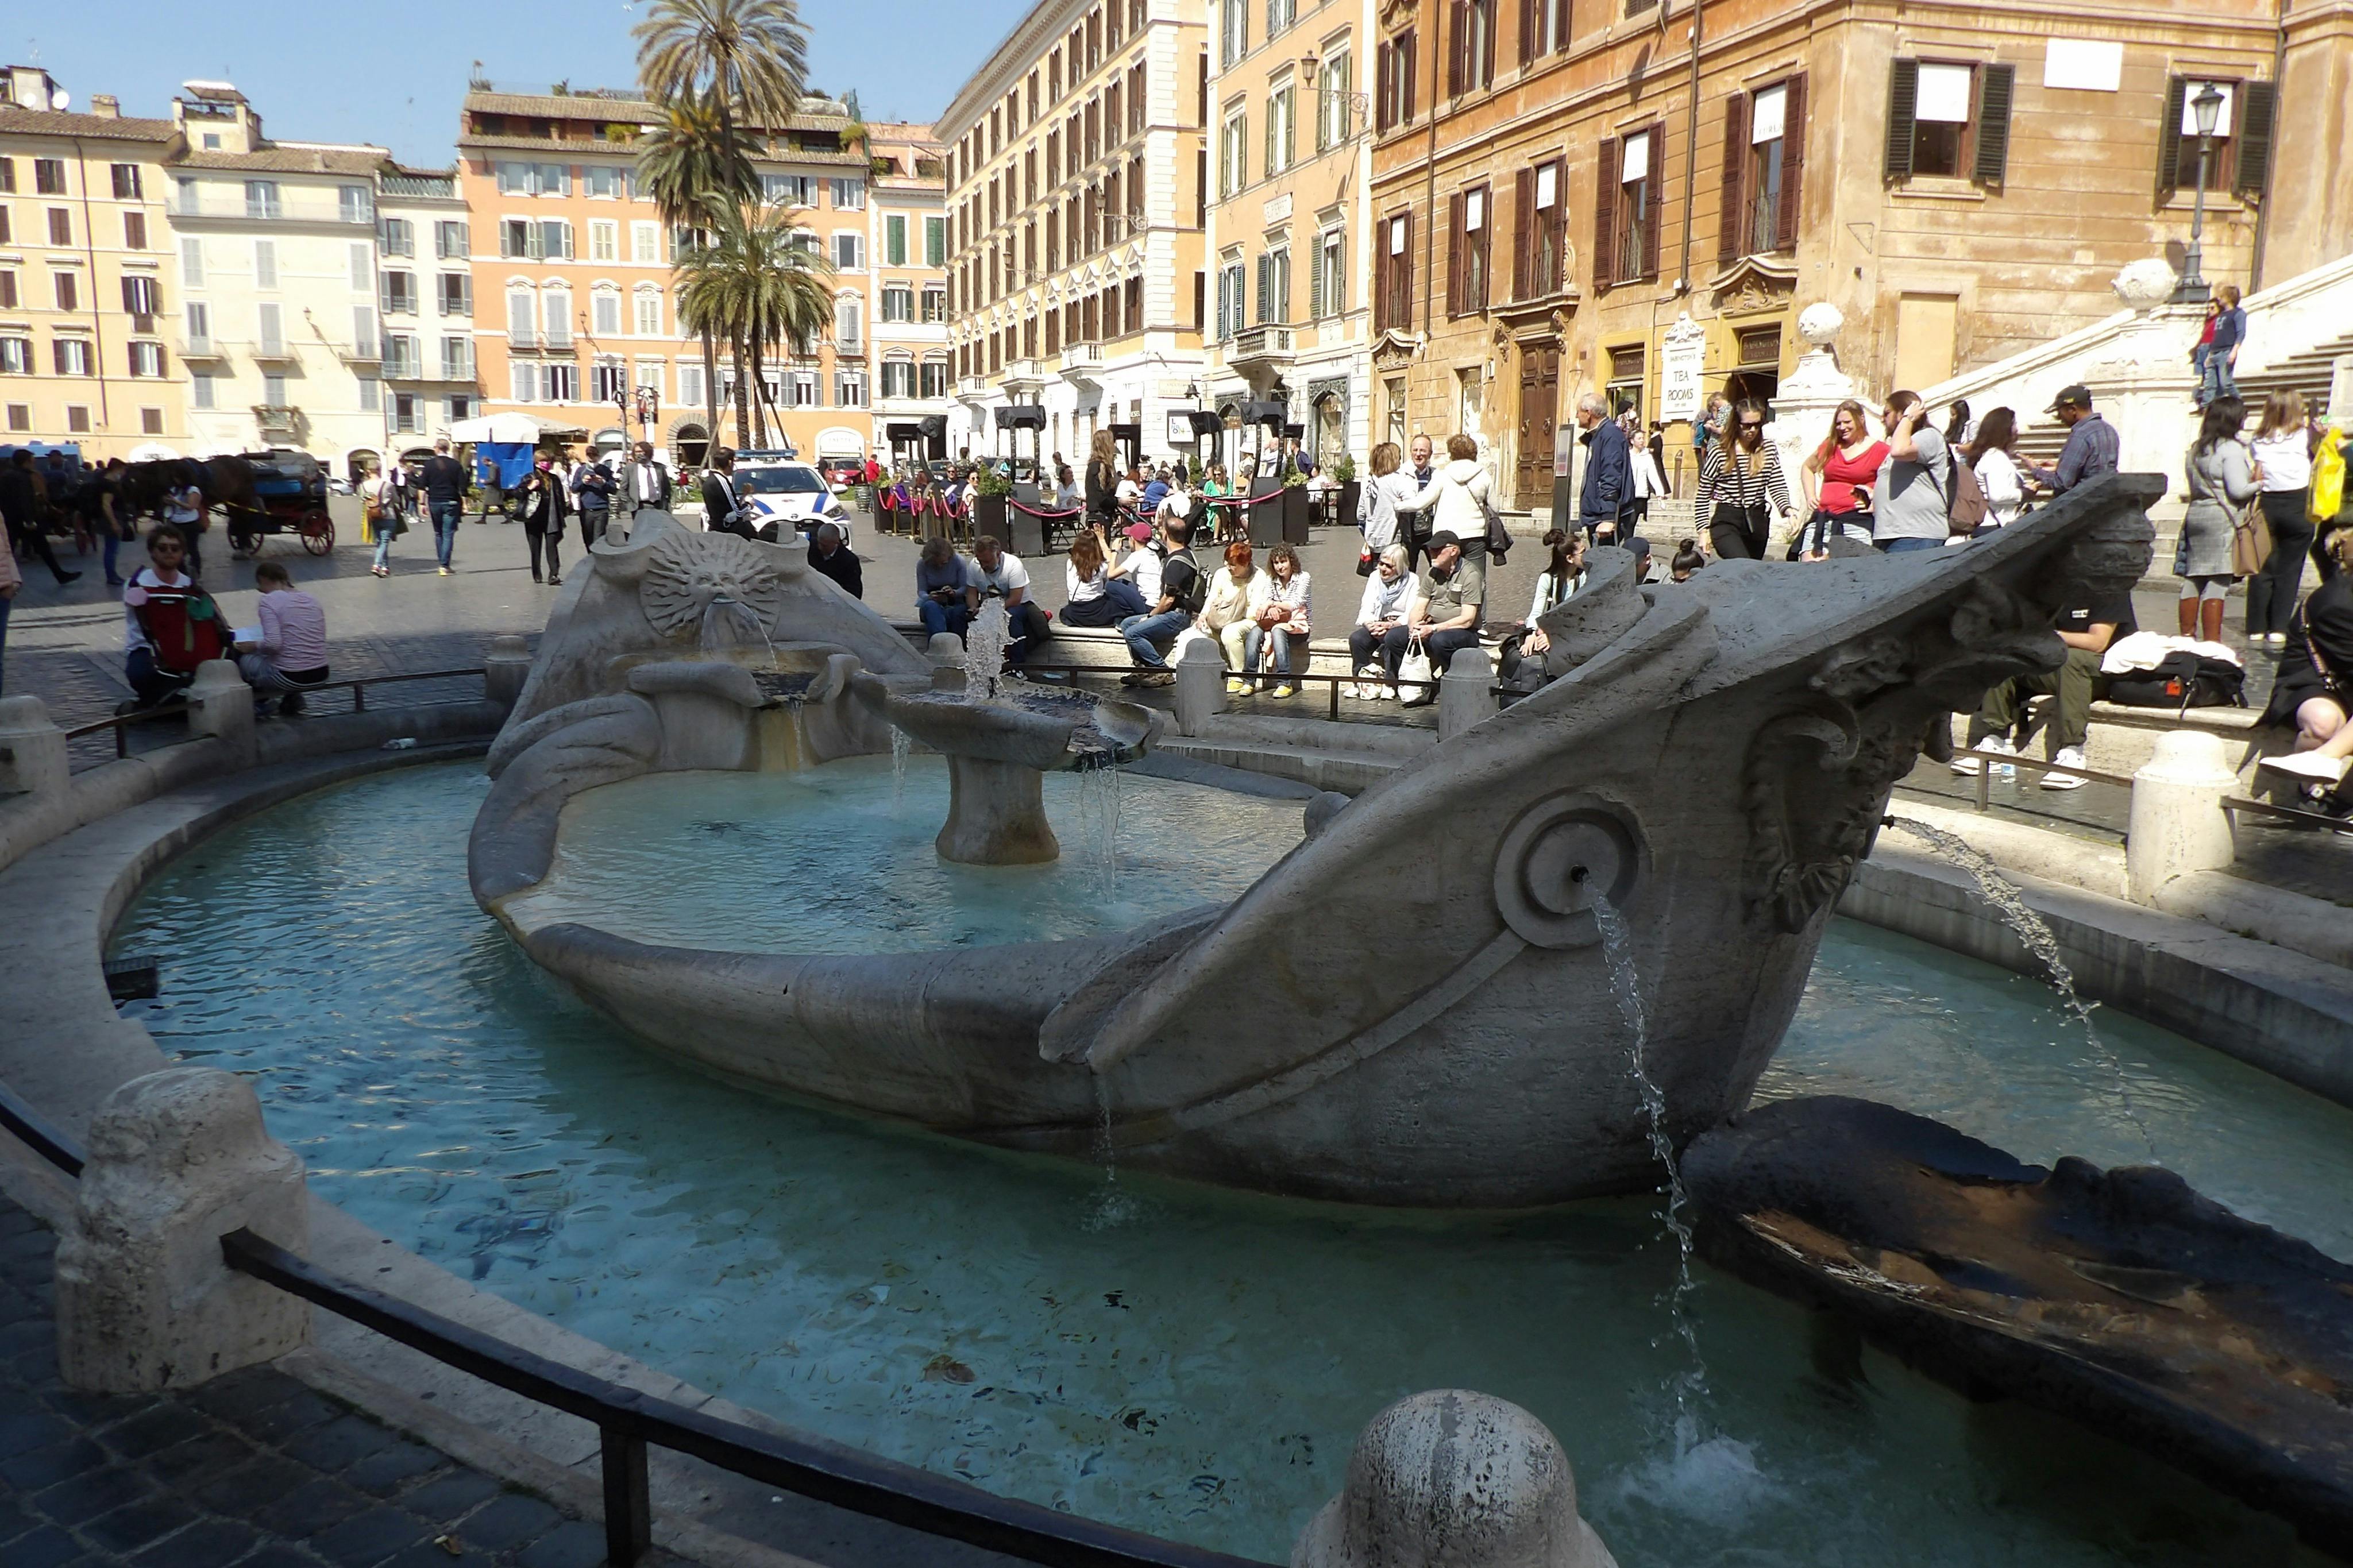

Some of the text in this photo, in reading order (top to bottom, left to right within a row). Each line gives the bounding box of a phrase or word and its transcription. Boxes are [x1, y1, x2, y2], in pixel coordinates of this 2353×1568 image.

[2213, 316, 2227, 330] H
[1673, 370, 1689, 382] TEA
[1668, 388, 1694, 400] ROOMS
